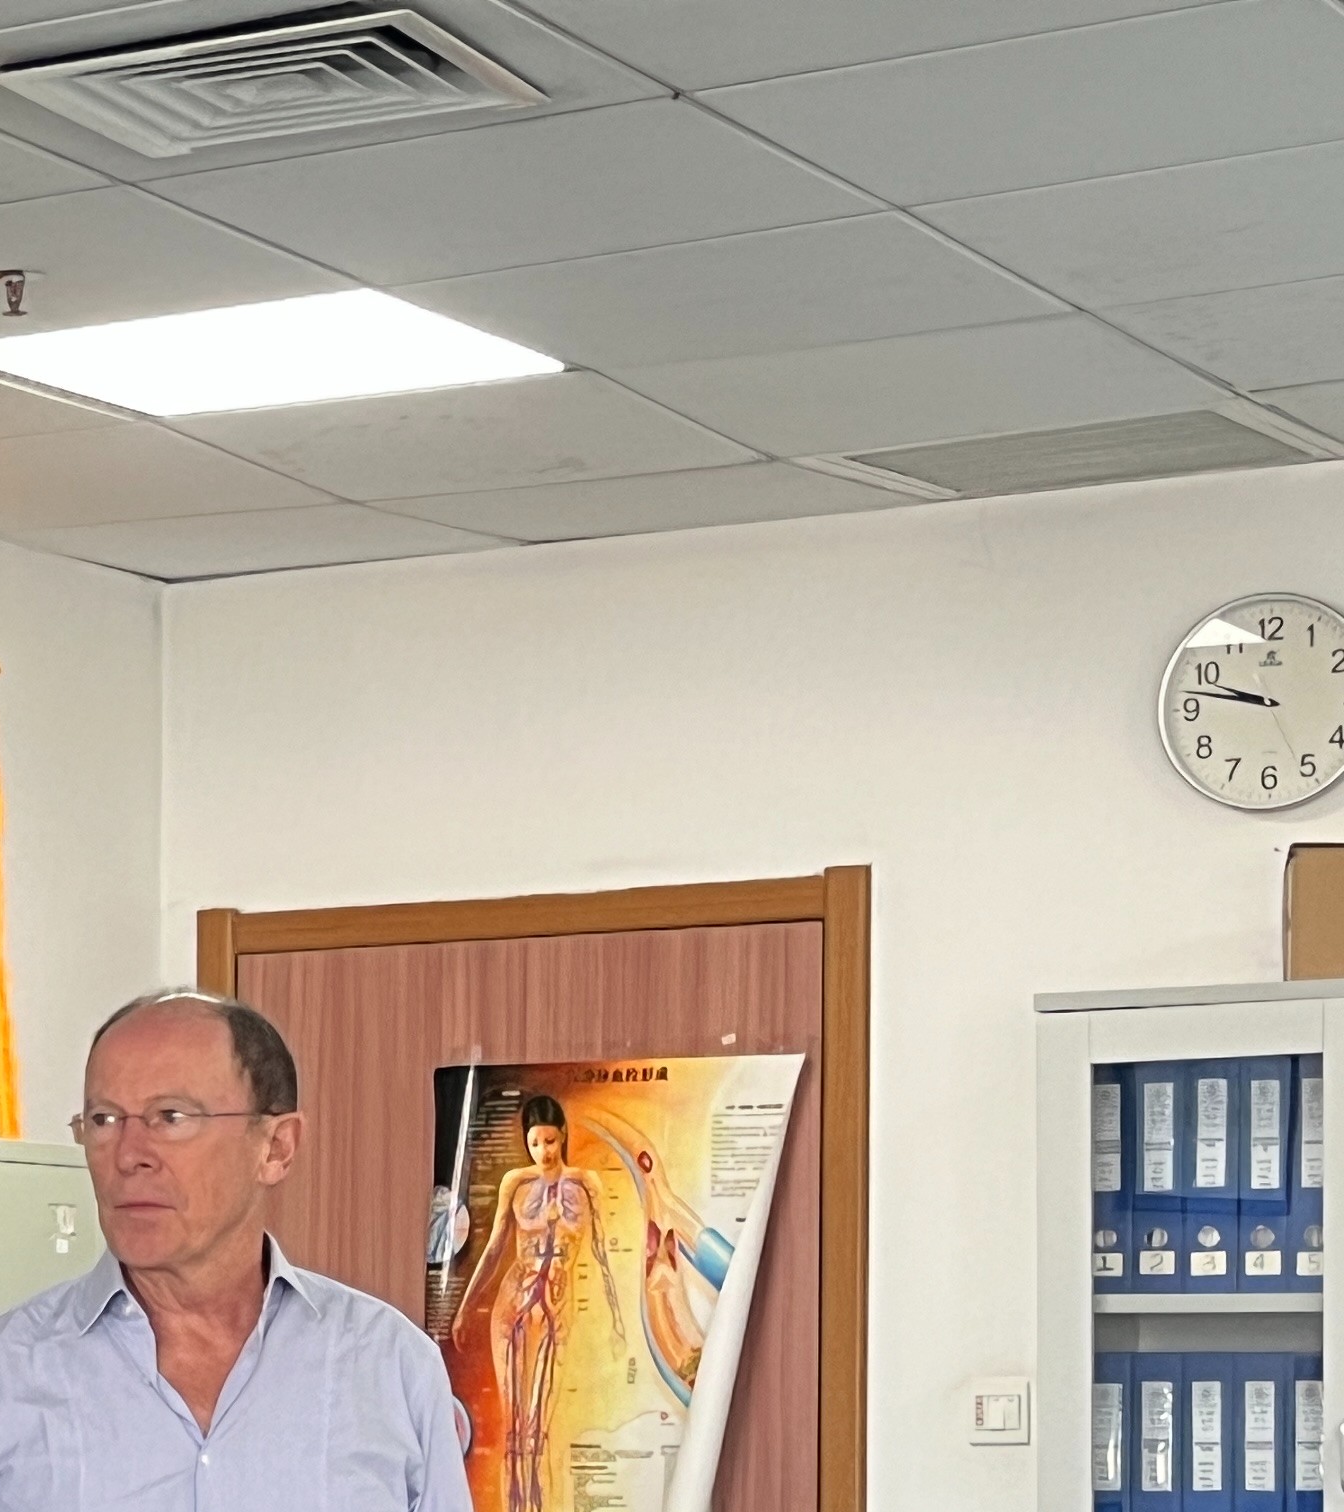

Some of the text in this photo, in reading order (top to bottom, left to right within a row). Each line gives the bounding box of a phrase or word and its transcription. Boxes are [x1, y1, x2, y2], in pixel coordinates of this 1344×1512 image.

[1259, 617, 1284, 641] 12
[1306, 623, 1315, 647] 1
[1331, 648, 1344, 674] 2
[1194, 661, 1220, 686] 10
[1183, 698, 1200, 722] 9
[1196, 735, 1213, 759] 8
[1328, 725, 1344, 749] 4
[1225, 758, 1242, 782] 7
[1261, 766, 1278, 790] 6
[1299, 754, 1317, 778] 5
